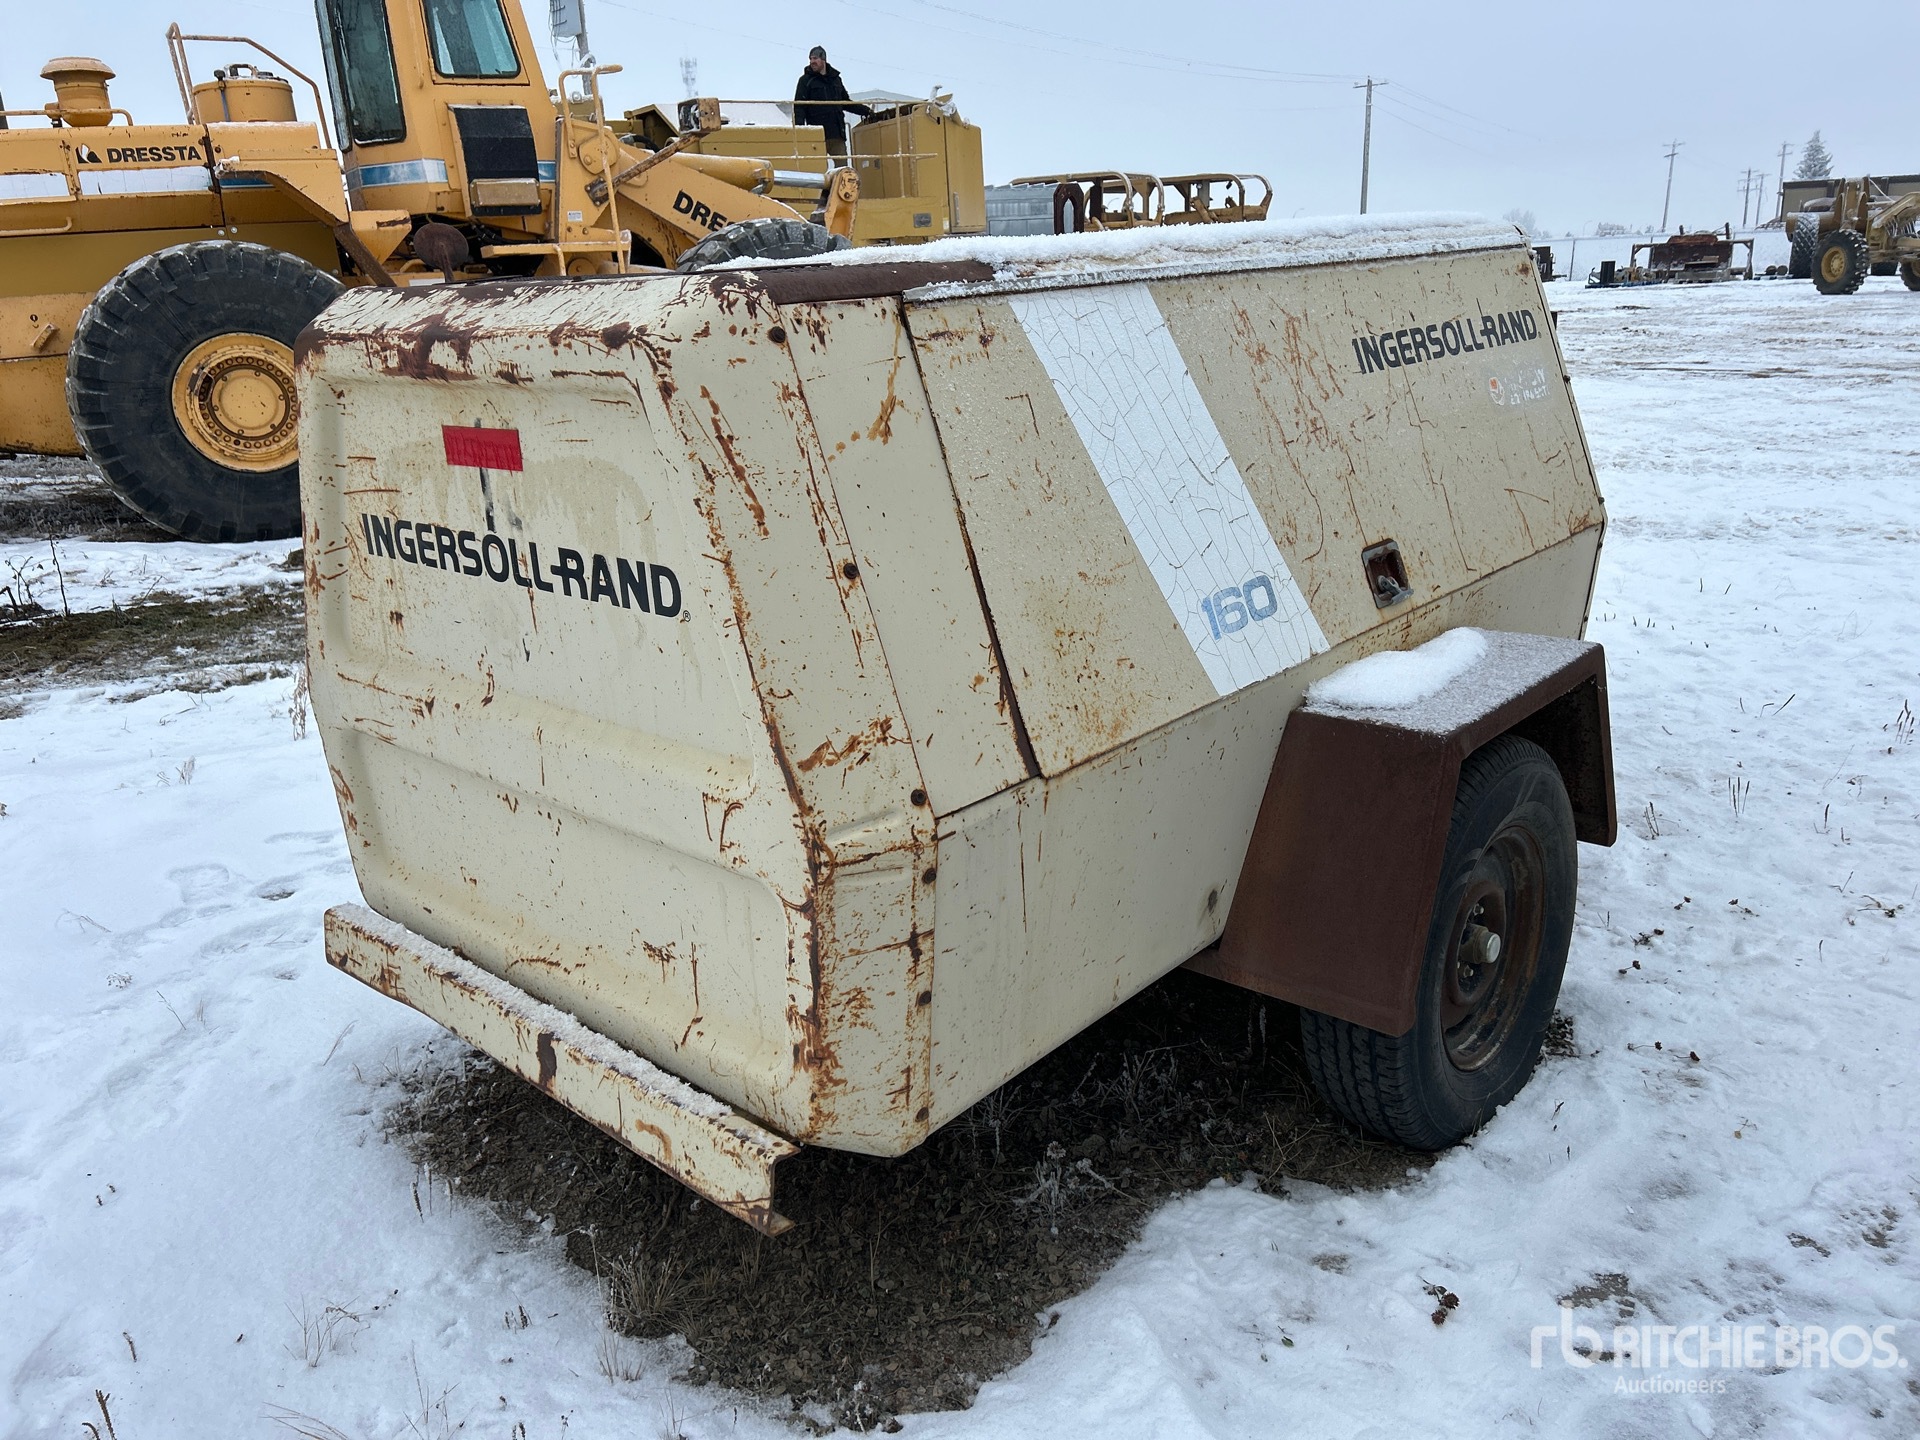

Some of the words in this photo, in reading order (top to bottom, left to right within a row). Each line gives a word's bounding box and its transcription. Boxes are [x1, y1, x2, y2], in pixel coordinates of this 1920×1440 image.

[106, 146, 202, 164] DRESSTA
[672, 189, 736, 232] DRE
[1352, 309, 1538, 375] INGERSOLL-RAND
[361, 512, 683, 618] INGERSOLL-RAND
[1201, 574, 1278, 640] 160
